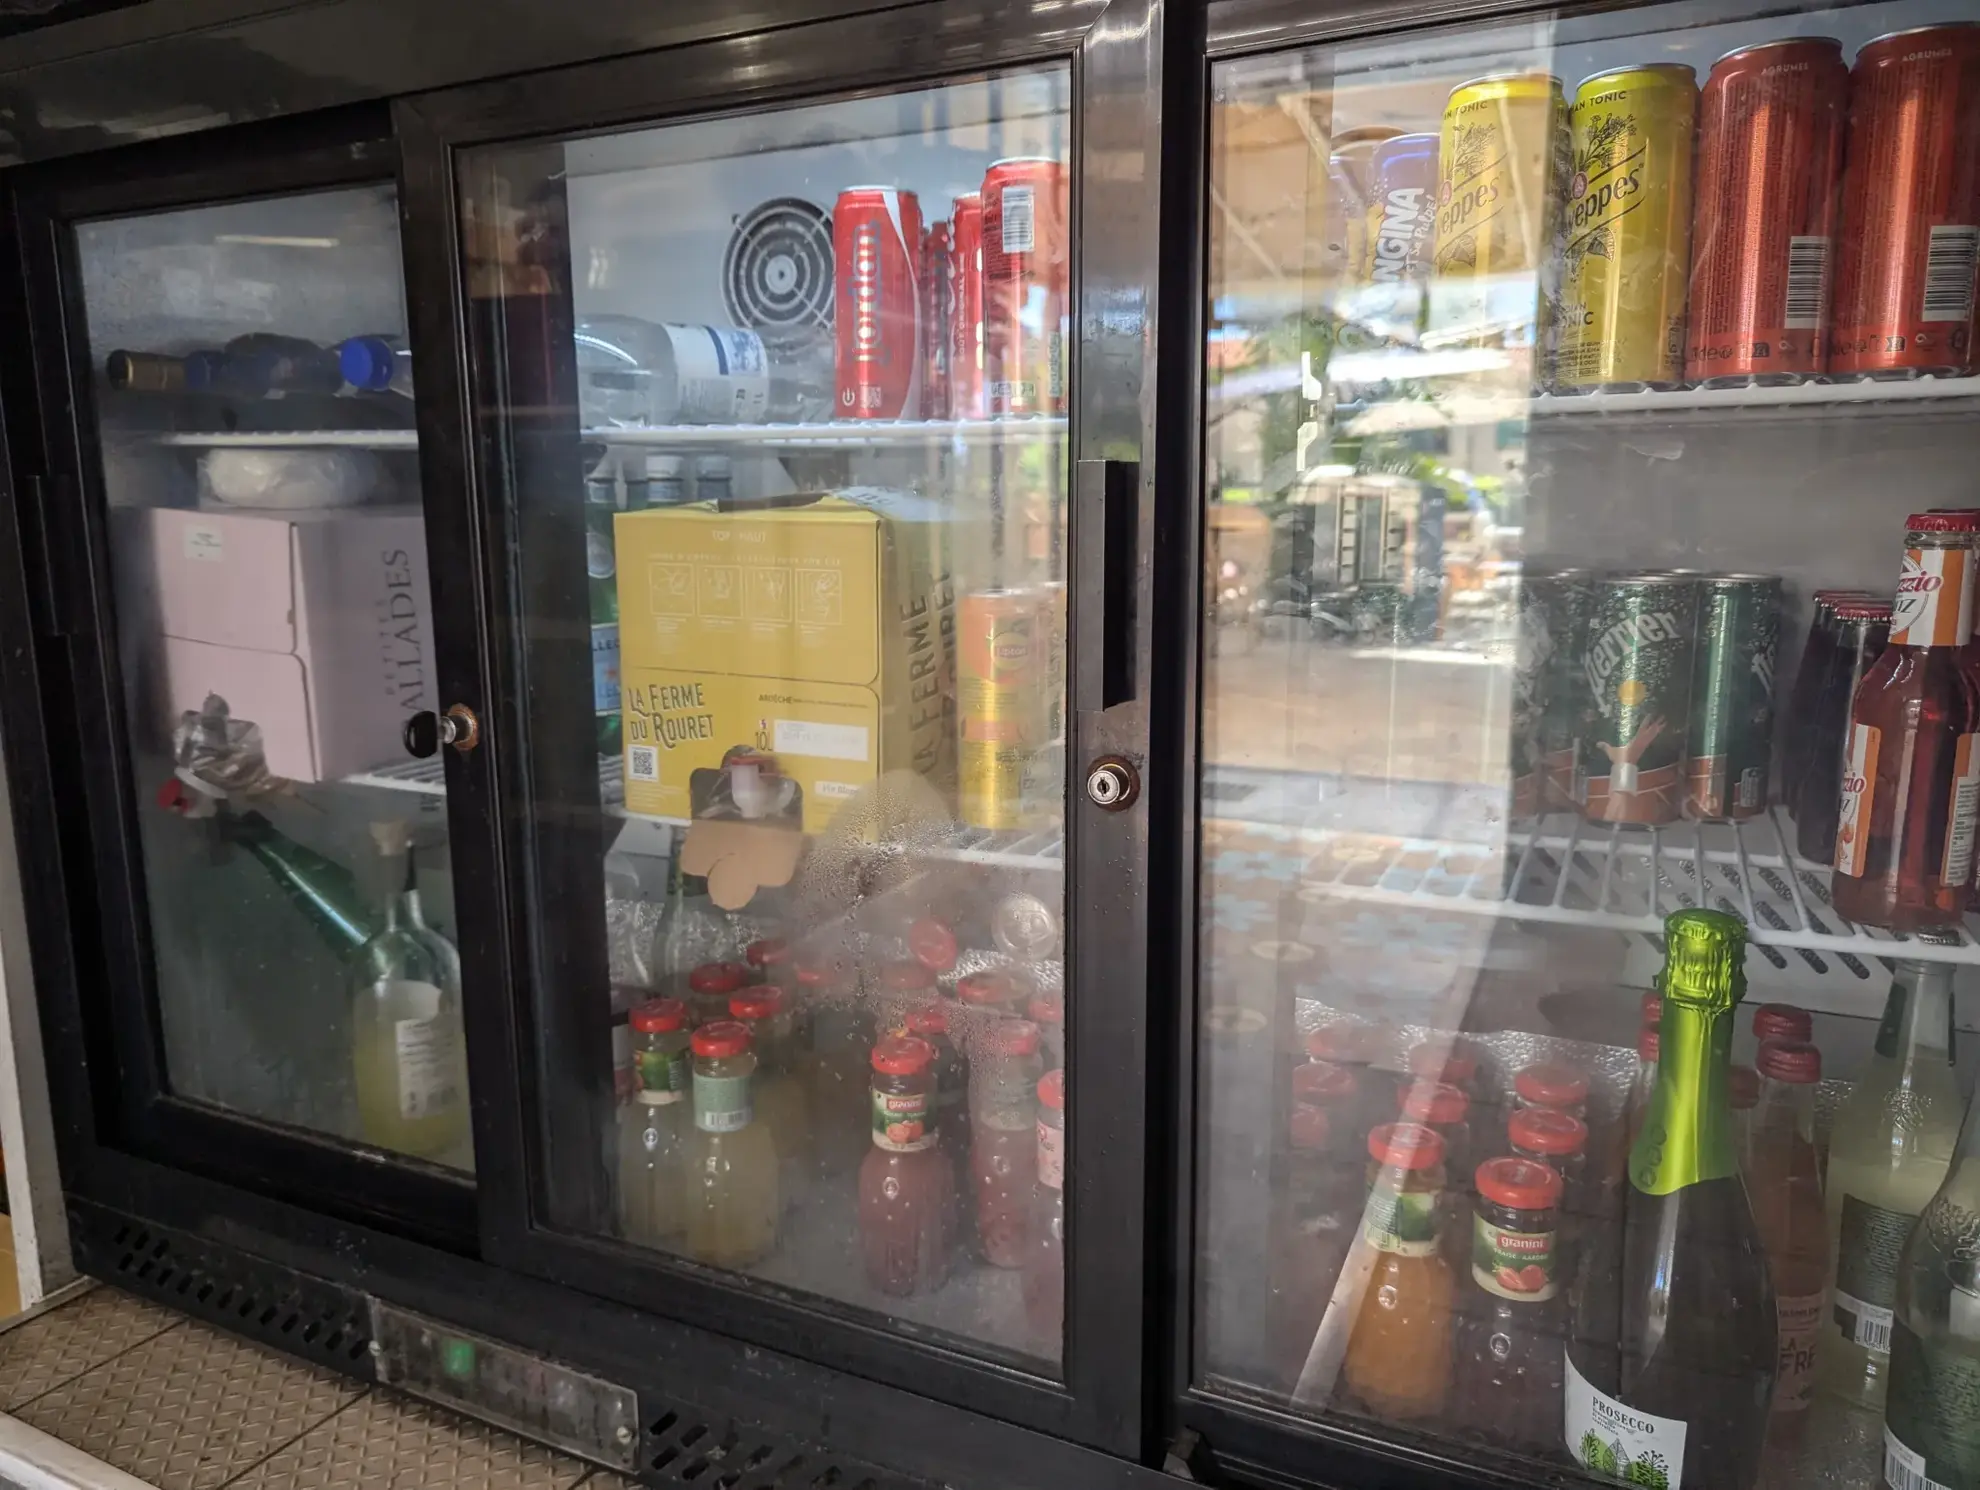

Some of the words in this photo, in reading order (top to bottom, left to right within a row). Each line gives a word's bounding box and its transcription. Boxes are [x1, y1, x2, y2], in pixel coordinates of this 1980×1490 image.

[1902, 48, 1952, 62] AGRUMES
[1761, 62, 1808, 75] AGRUMES
[1456, 101, 1488, 114] TONIC
[1590, 91, 1627, 107] TONIC
[848, 221, 890, 366] Jordan
[382, 549, 425, 714] ALLADES
[900, 594, 941, 733] FERME
[995, 646, 1027, 657] Lipton
[627, 687, 651, 718] LA
[649, 682, 707, 713] FERME
[630, 719, 649, 741] DU
[653, 711, 714, 749] ROURET
[1501, 1236, 1544, 1249] granini
[1592, 1396, 1655, 1434] PROSECCO
